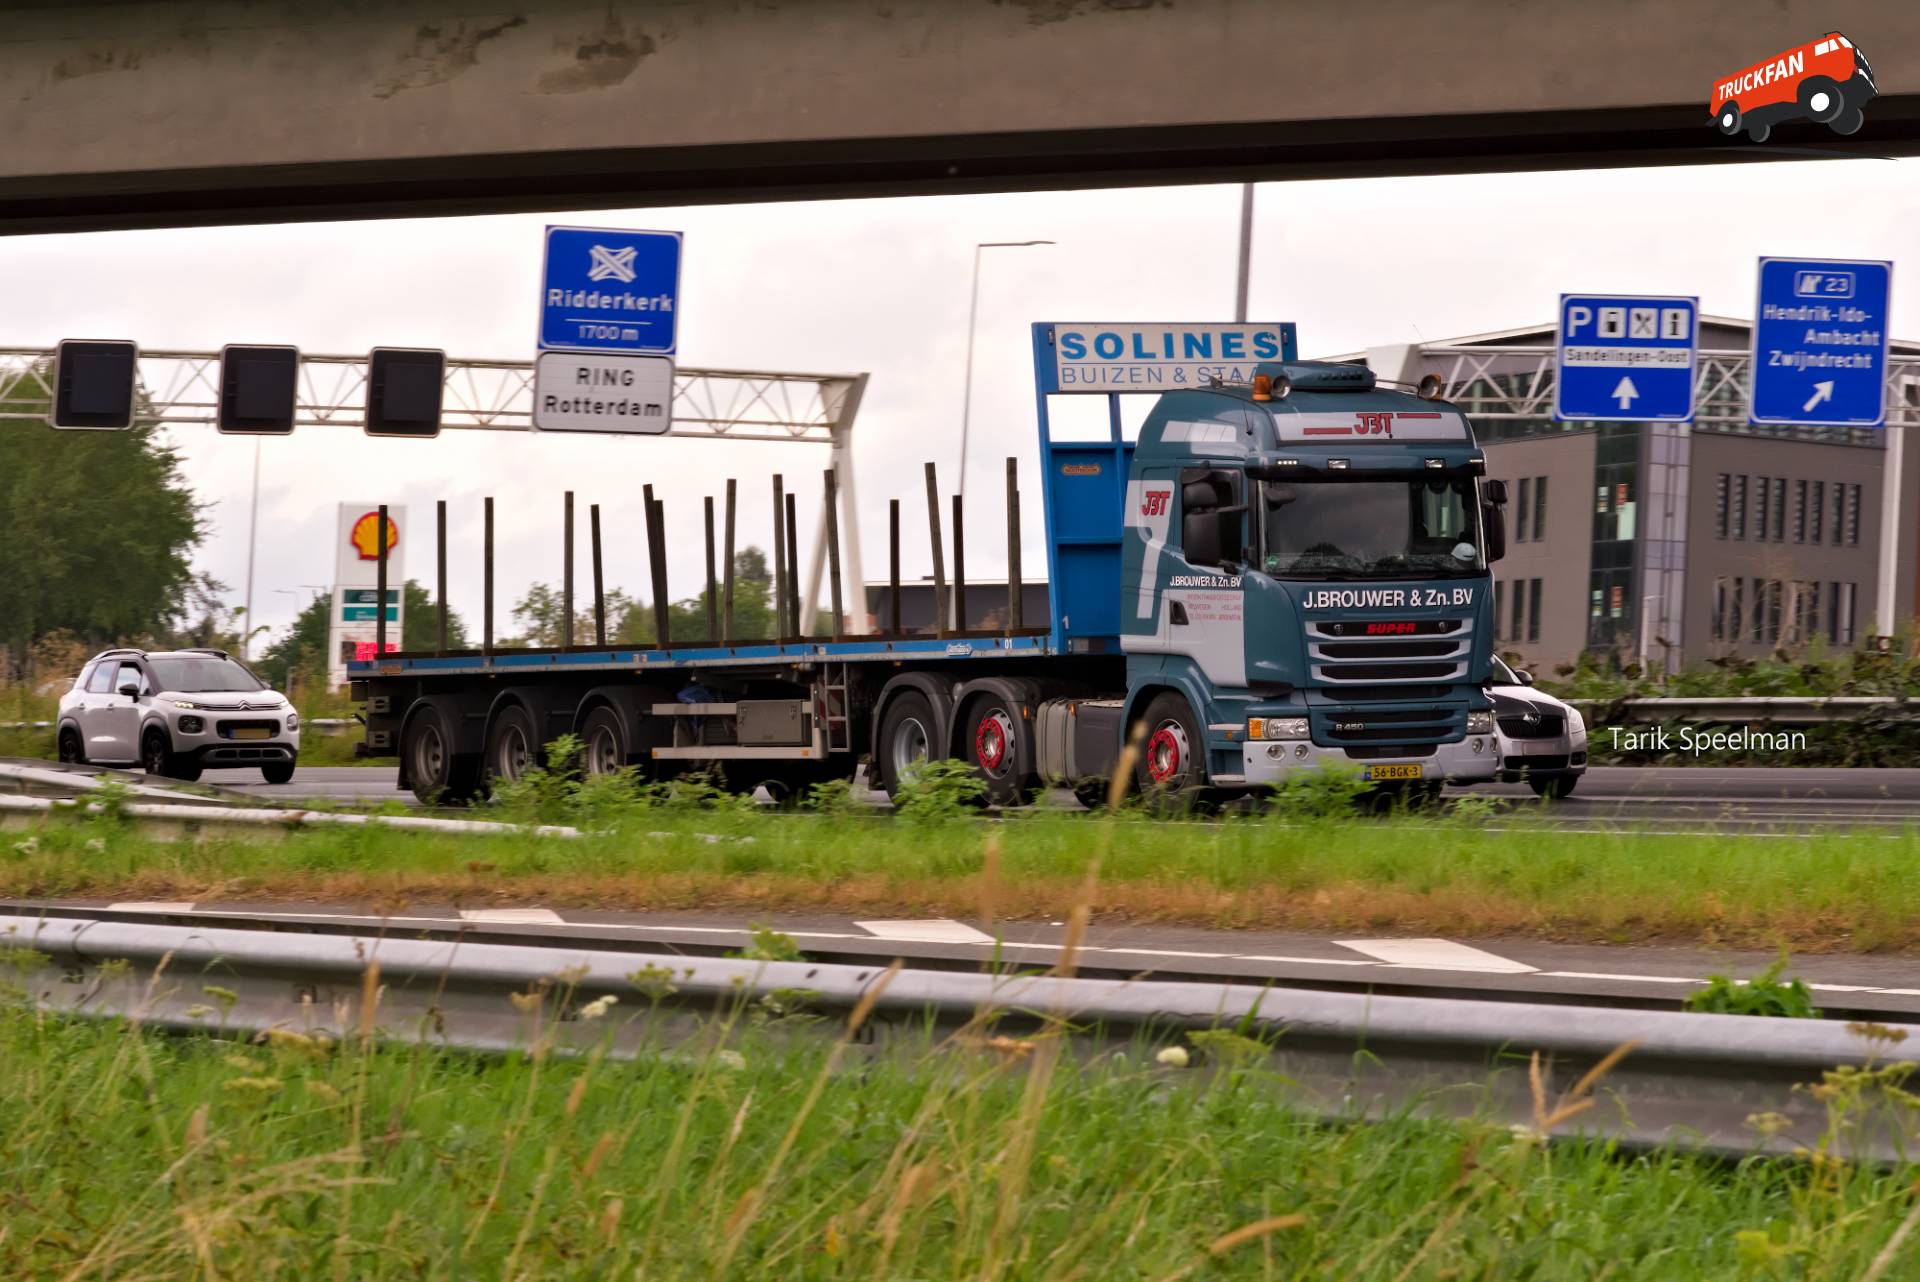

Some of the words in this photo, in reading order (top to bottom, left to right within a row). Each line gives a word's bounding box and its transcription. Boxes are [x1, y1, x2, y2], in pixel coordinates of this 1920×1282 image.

[1824, 277, 1849, 293] 23
[547, 288, 673, 312] Ridderkerk
[1763, 304, 1873, 323] Hendrik-Ido-
[578, 325, 620, 340] 1700
[621, 328, 639, 341] m
[1803, 328, 1880, 346] Ambacht
[1060, 331, 1279, 360] SOLINES
[1768, 350, 1873, 372] Zwijndrecht
[576, 367, 636, 387] RING
[1062, 366, 1162, 384] BUIZEN
[1172, 367, 1187, 383] &
[543, 395, 663, 417] Rotterdam
[1354, 412, 1394, 434] JBT
[1141, 491, 1171, 516] JBT
[1169, 576, 1211, 587] J.BROUWER
[1211, 576, 1218, 587] &
[1230, 577, 1242, 587] BV
[1303, 590, 1405, 609] J.BROUWER
[1410, 589, 1422, 607] &
[1425, 589, 1451, 606] Zn.
[1453, 588, 1474, 605] BV
[1366, 623, 1416, 635] SUPER
[1374, 766, 1418, 778] 56-BGK-3
